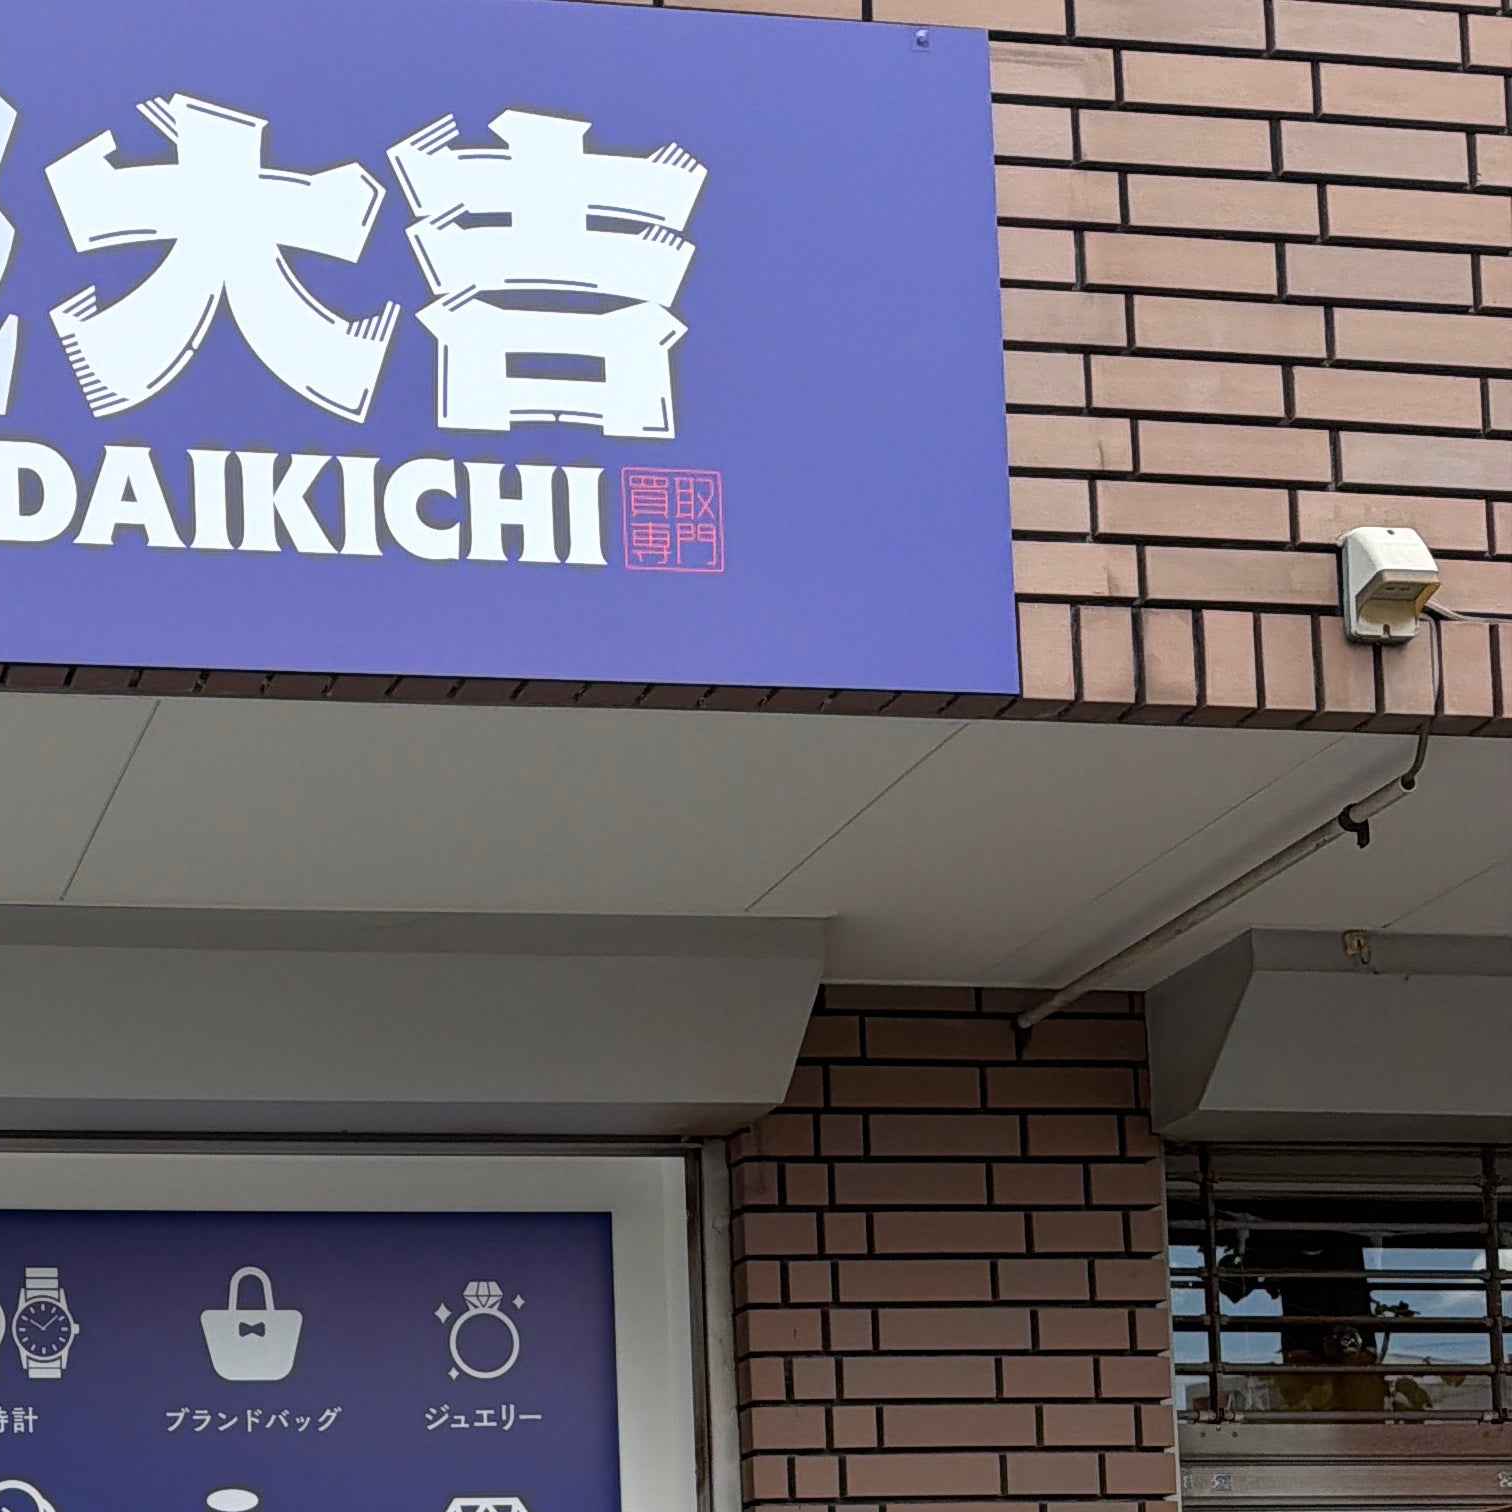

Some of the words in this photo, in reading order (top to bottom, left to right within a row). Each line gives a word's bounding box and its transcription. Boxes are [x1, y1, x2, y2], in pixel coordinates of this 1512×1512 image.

[629, 475, 715, 520] 買取
[166, 1406, 343, 1433] ブランドバッグ
[425, 1403, 542, 1431] ジュエリー
